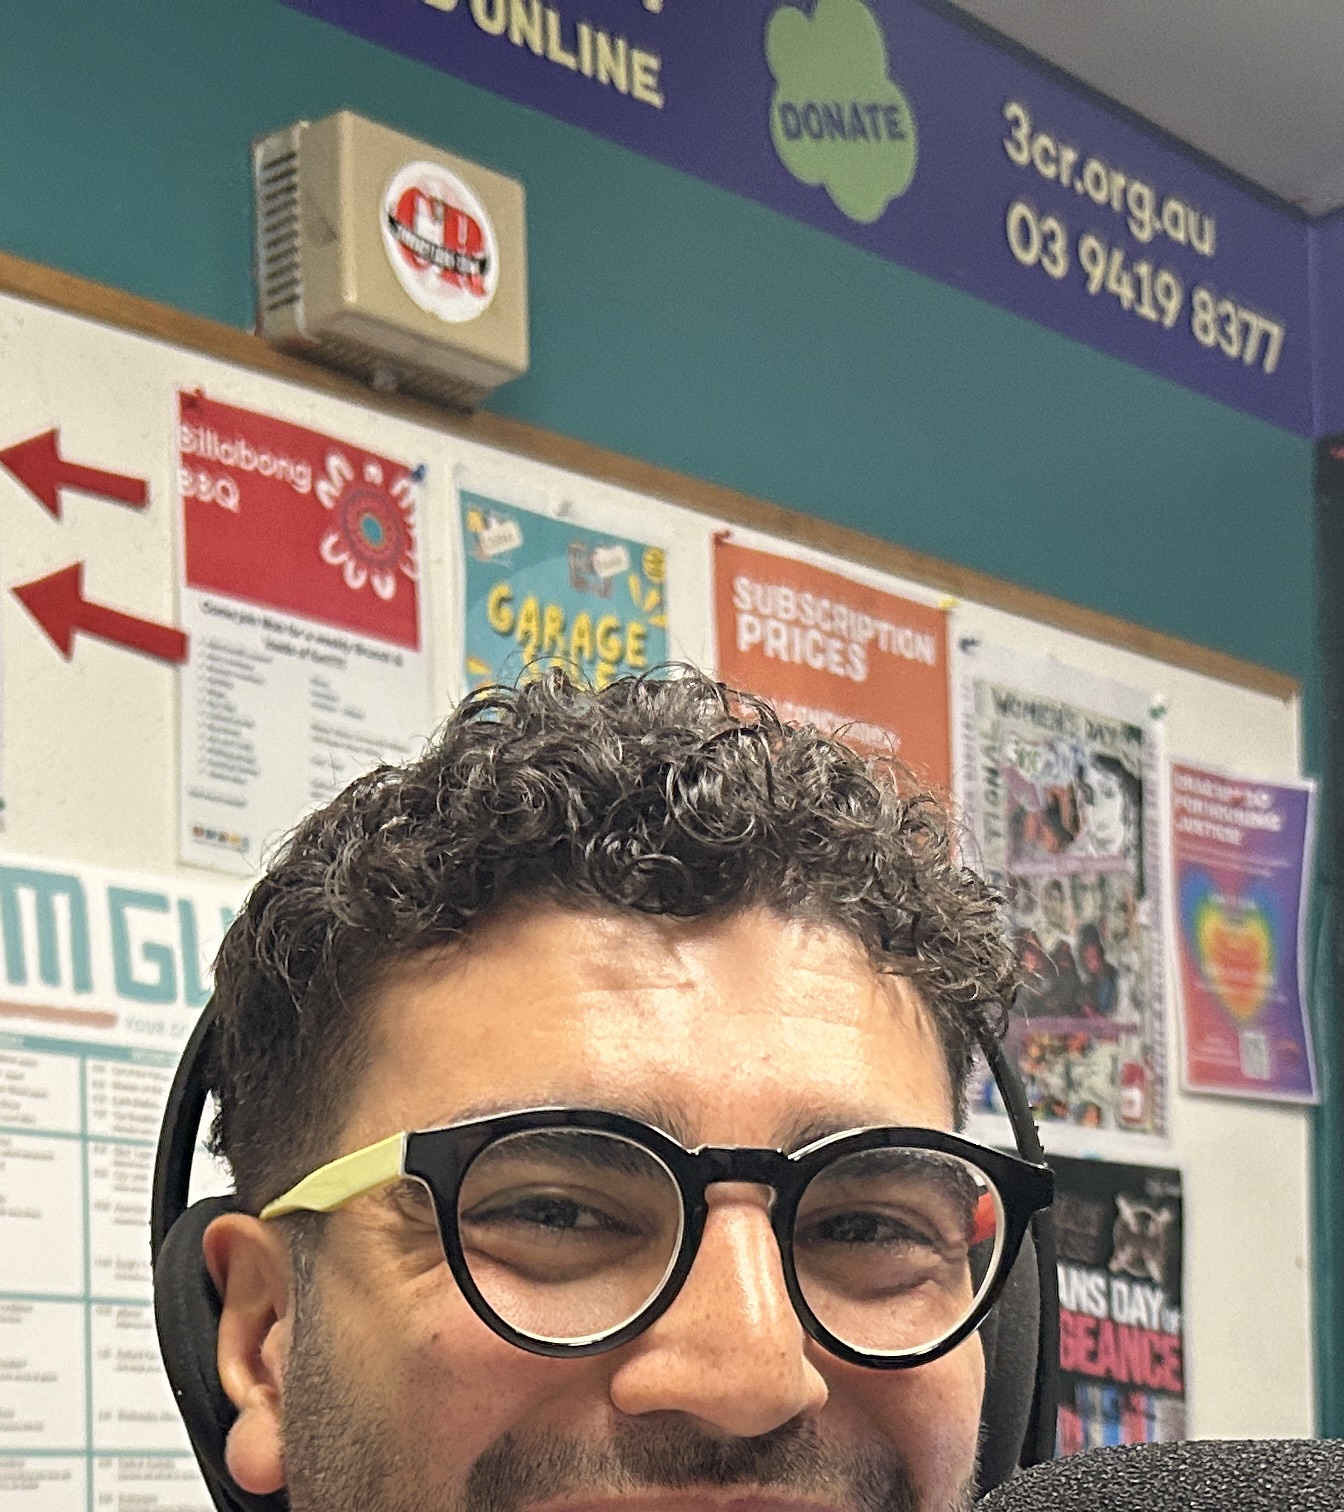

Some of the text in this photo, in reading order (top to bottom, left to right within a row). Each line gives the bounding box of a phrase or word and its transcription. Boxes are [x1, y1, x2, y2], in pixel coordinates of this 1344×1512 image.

[779, 101, 906, 143] DONATE
[1002, 100, 1216, 257] 3cr.org.au
[1006, 200, 1286, 375] 03 9419 8377
[181, 423, 313, 494] Billabong
[487, 582, 648, 669] GARAGE
[732, 575, 938, 666] SUBSCRIPTION
[735, 612, 870, 683] PRICES
[1109, 1276, 1165, 1331] DAY
